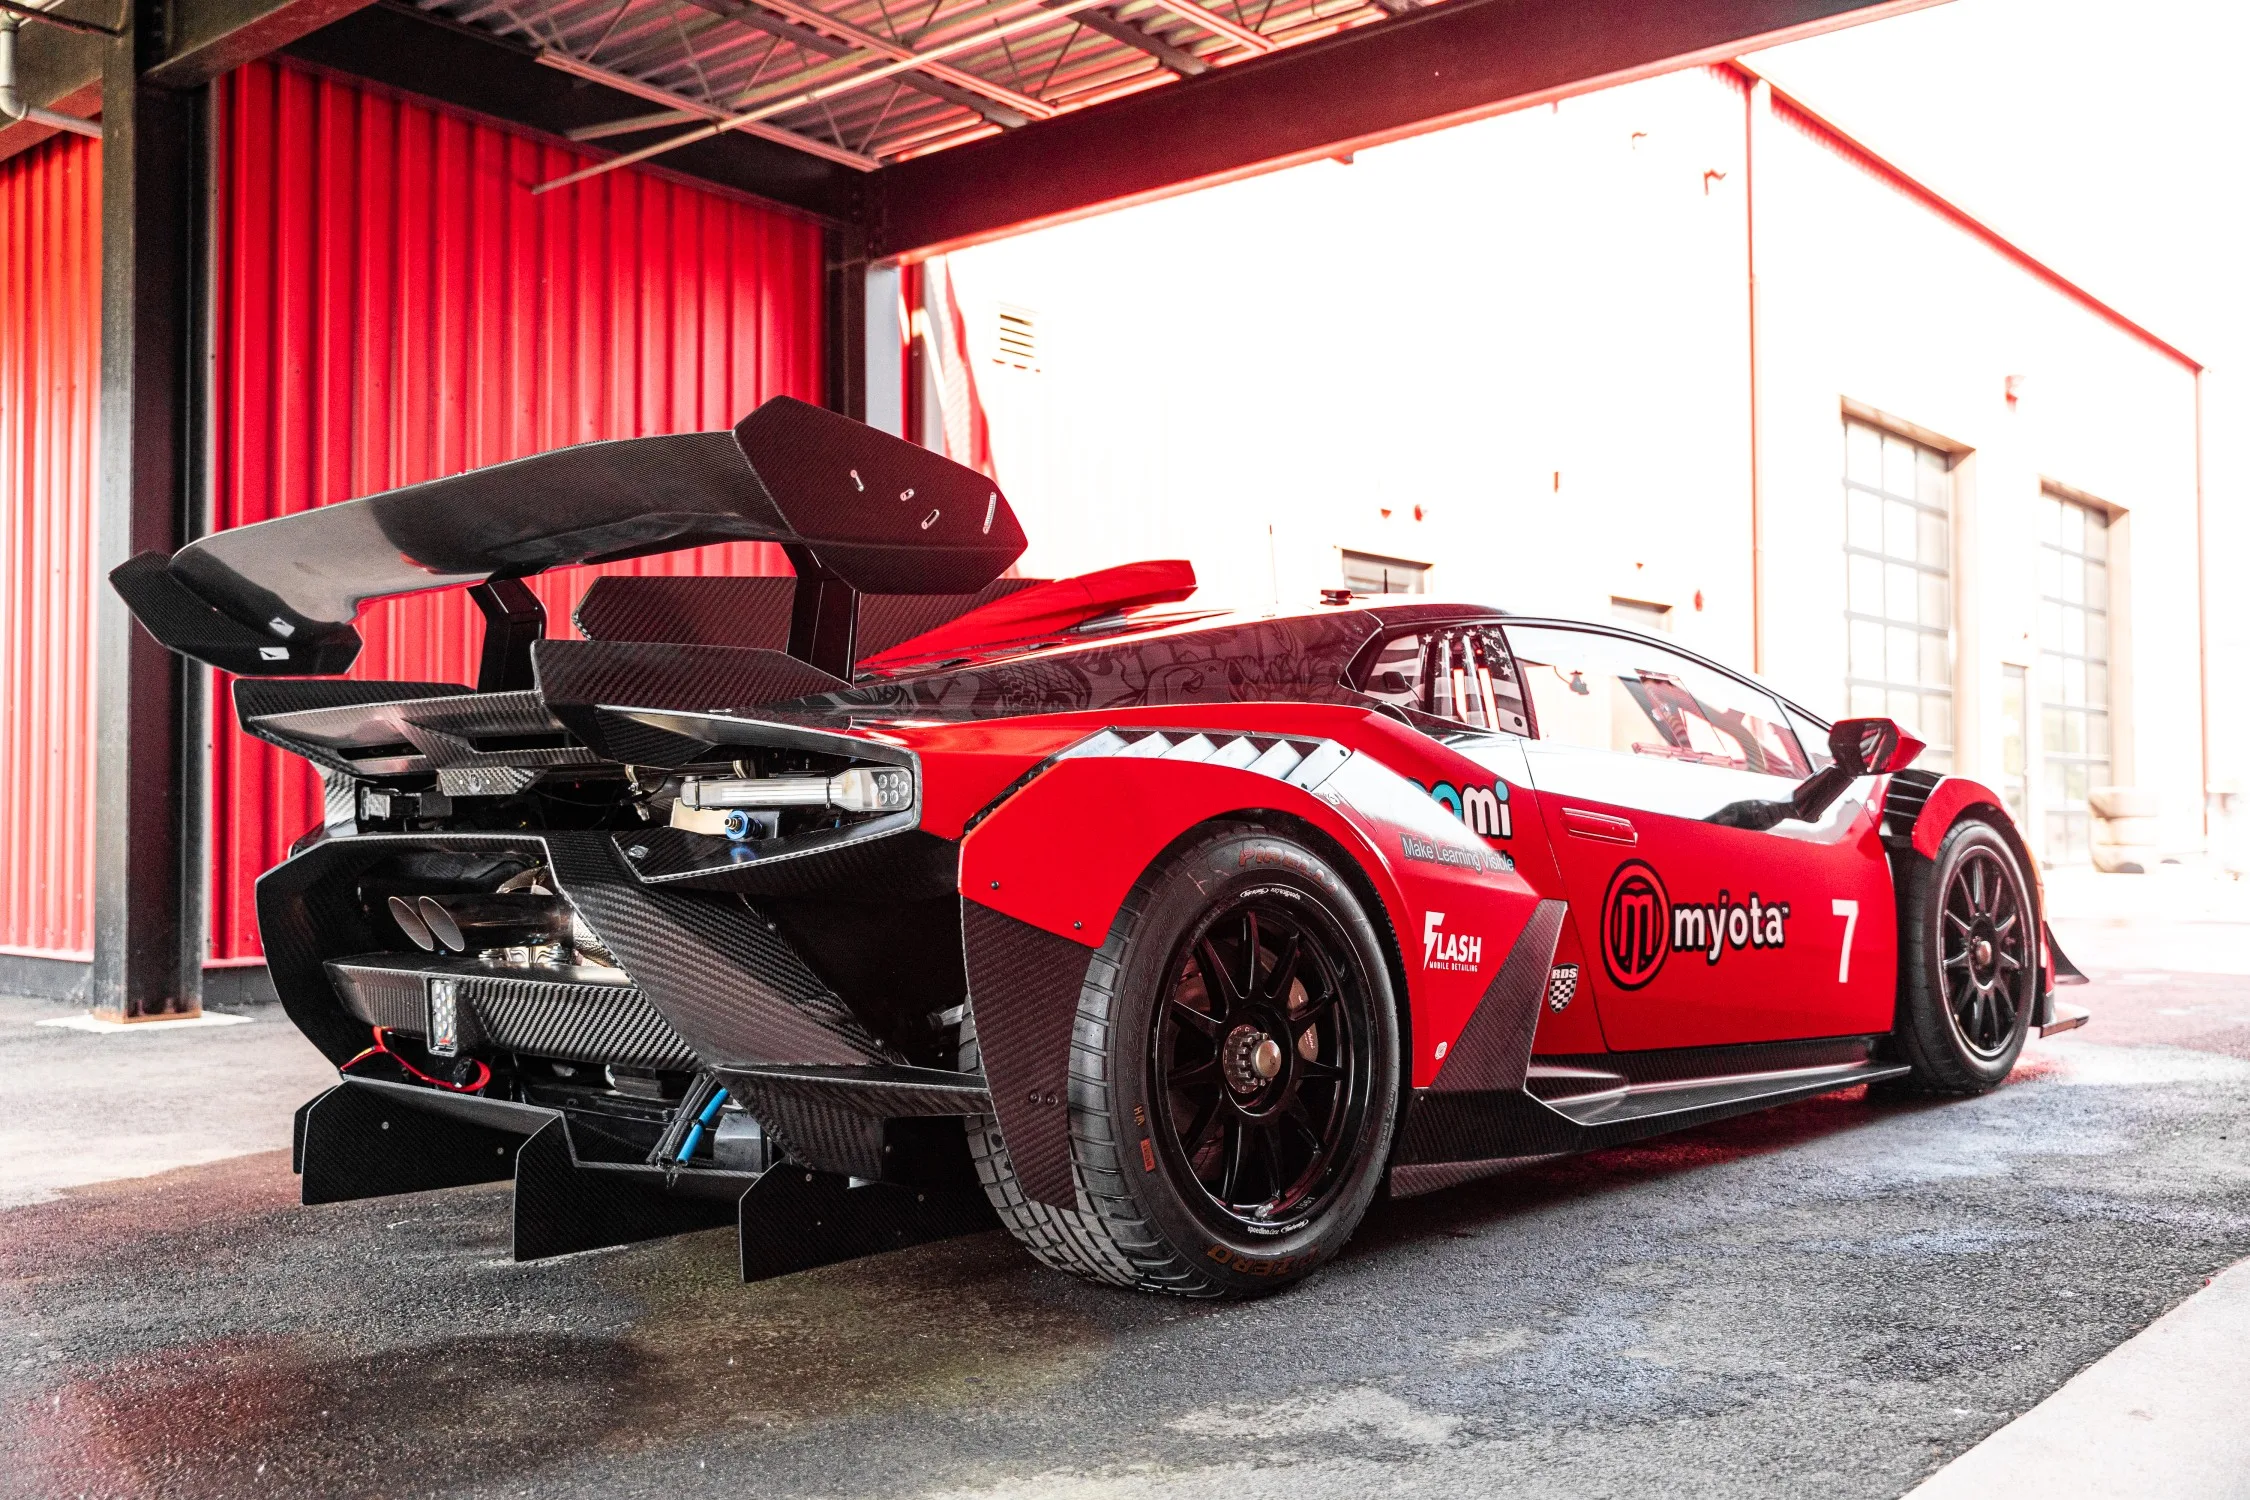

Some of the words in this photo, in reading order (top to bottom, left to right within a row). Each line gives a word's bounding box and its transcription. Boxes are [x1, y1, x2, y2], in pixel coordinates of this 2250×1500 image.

[1238, 845, 1339, 894] PIRELLI
[1402, 837, 1434, 859] Make
[1435, 842, 1481, 871] Learning
[1423, 911, 1482, 971] FLASH
[1831, 899, 1859, 983] 7
[1429, 960, 1449, 970] MOBILE
[1451, 962, 1478, 973] DETAILING
[1551, 967, 1577, 980] RDS
